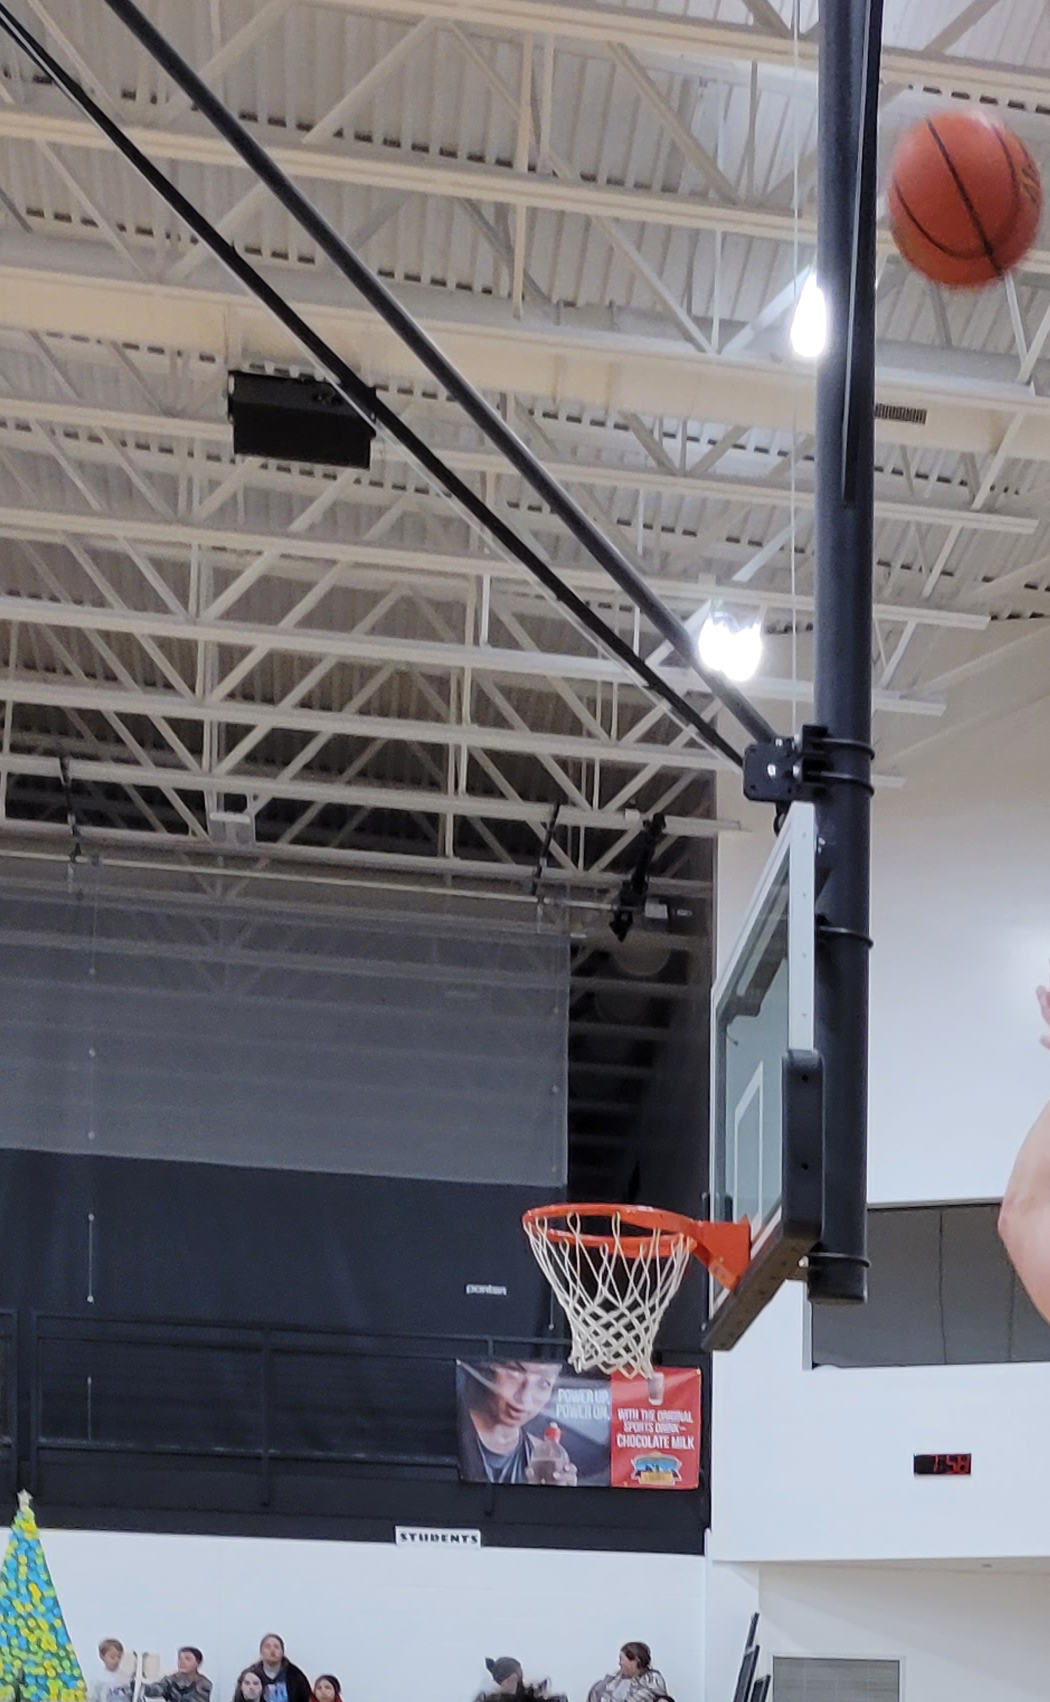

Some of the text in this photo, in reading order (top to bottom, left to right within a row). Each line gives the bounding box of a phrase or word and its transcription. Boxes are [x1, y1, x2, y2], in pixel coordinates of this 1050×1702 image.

[557, 1388, 593, 1404] POWER
[555, 1403, 592, 1419] POWER
[617, 1408, 640, 1421] WITH
[623, 1421, 653, 1433] SPORTS
[616, 1434, 695, 1449] CHOCOLATE MILK
[400, 1532, 479, 1544] STUDENTS
